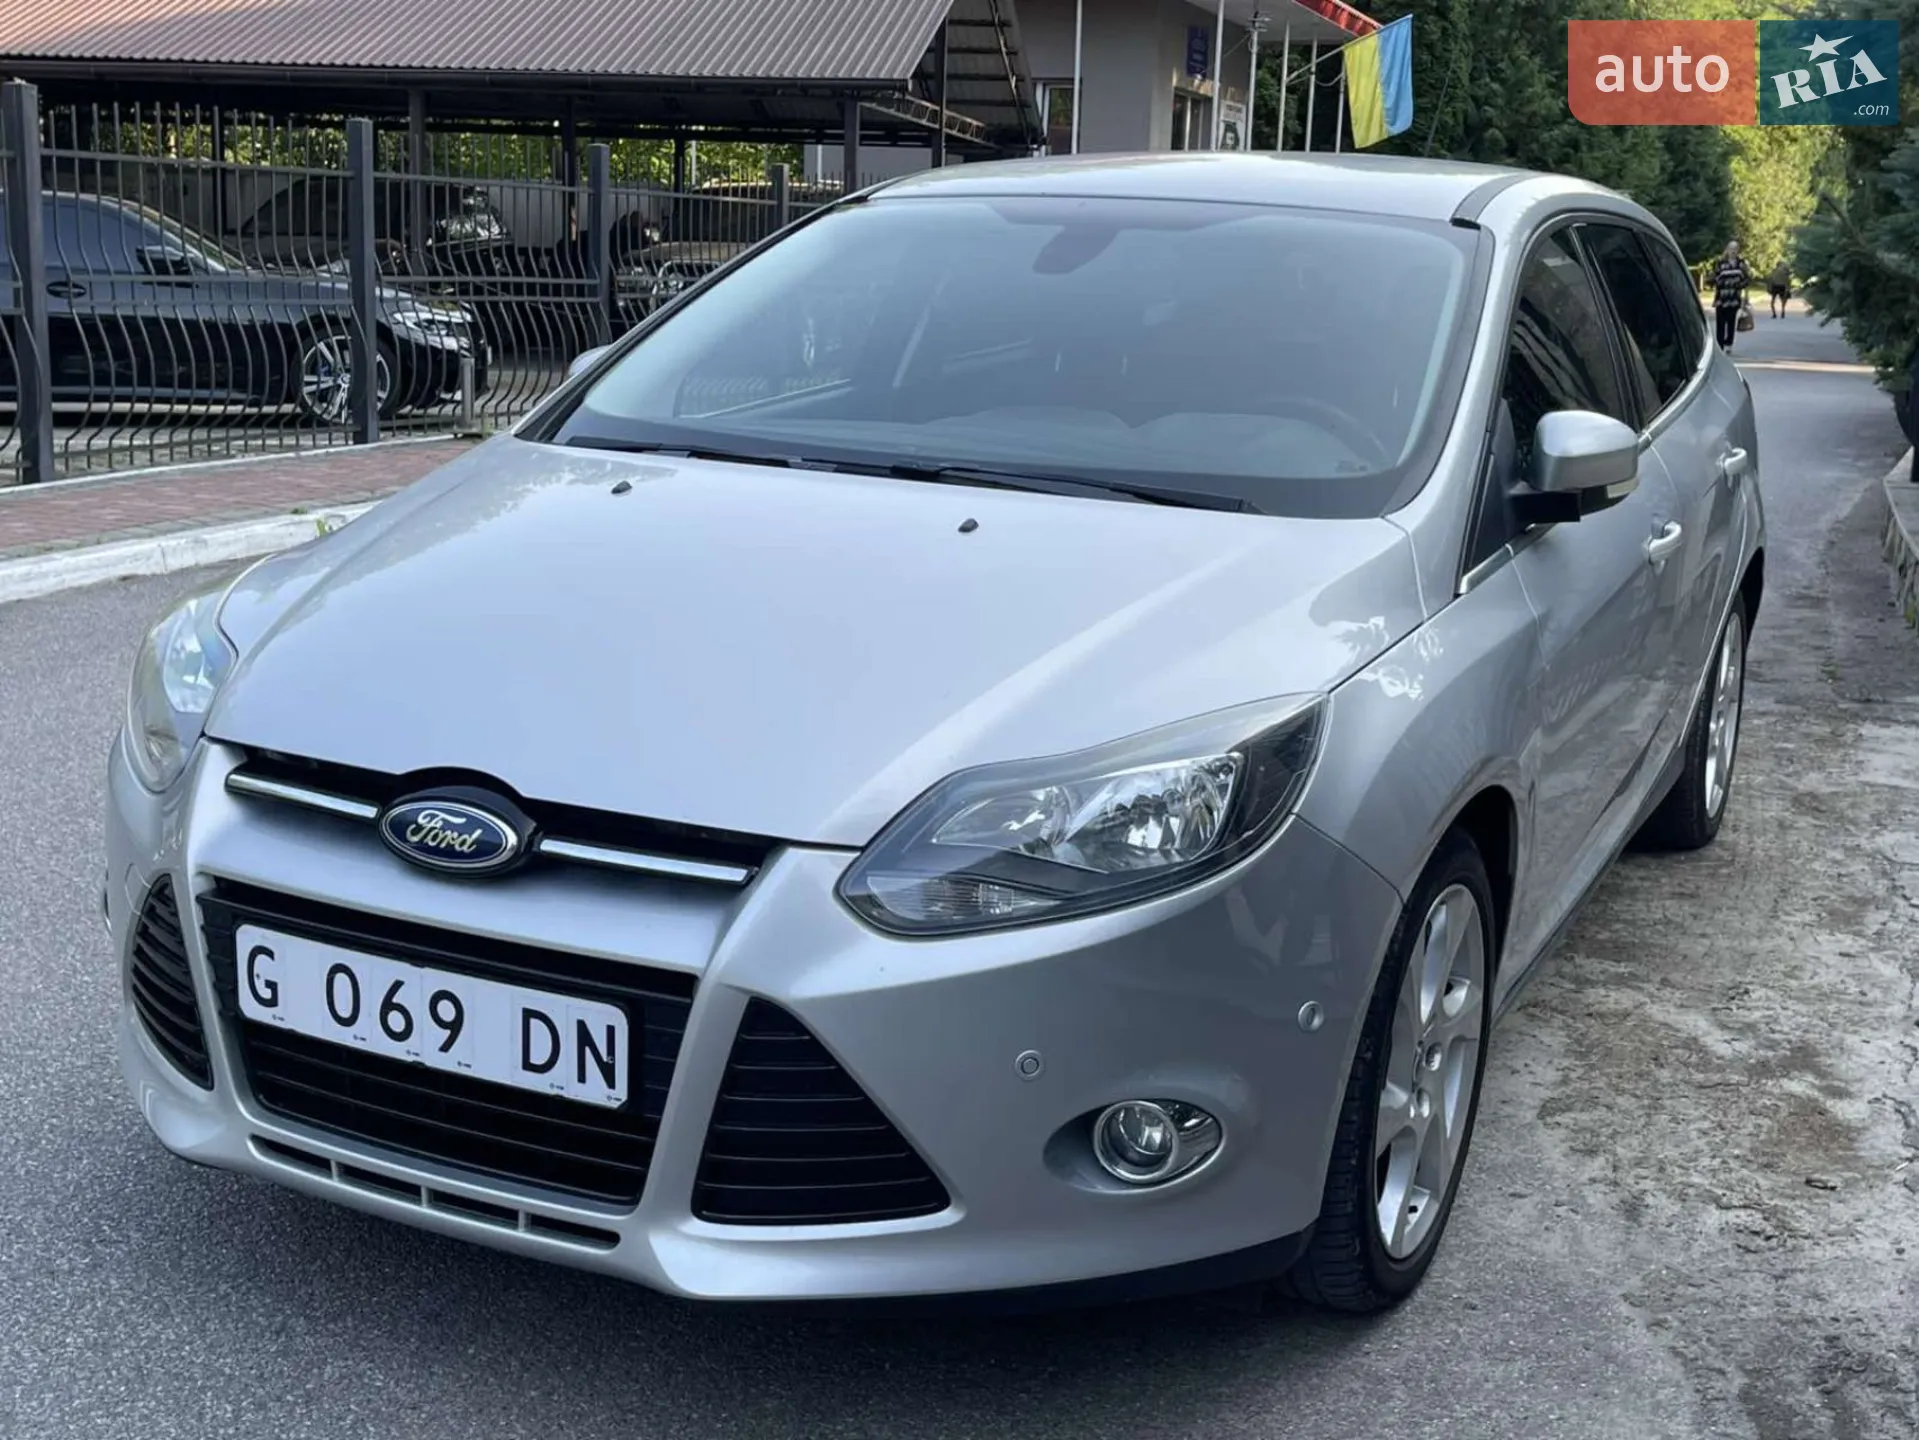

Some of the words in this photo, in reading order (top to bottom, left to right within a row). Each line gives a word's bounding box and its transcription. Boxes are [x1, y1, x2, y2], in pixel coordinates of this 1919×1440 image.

[406, 809, 483, 853] Ford
[246, 944, 279, 1008] G
[325, 963, 465, 1053] 069
[521, 1007, 616, 1090] DN
